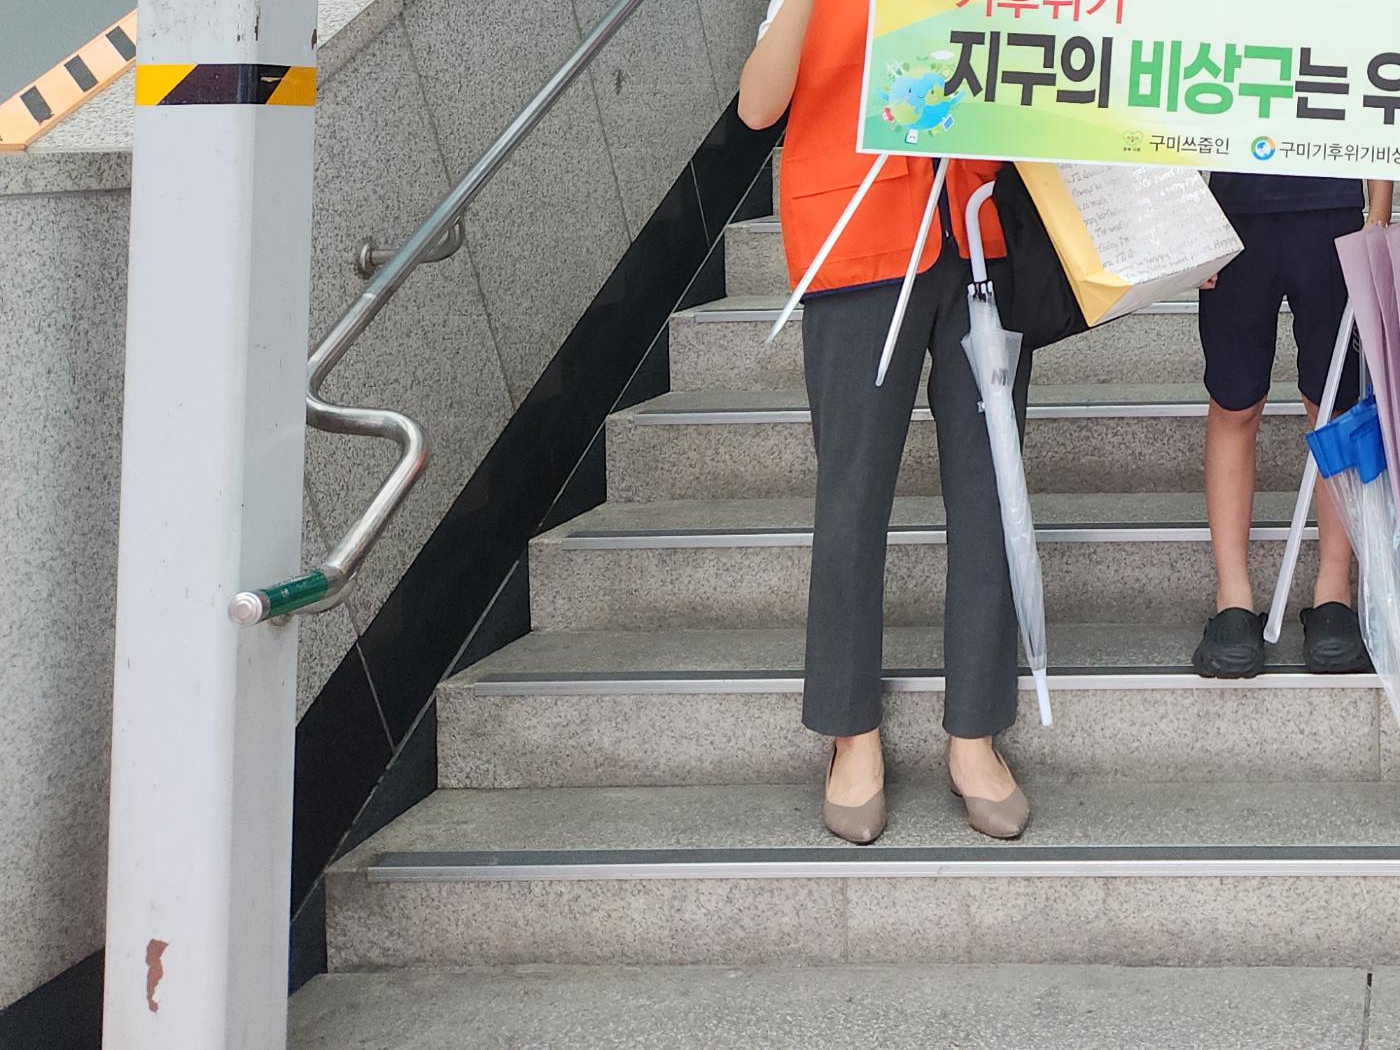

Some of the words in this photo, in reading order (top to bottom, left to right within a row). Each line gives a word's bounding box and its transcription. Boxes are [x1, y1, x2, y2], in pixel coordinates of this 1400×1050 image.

[944, 29, 1114, 109] 지구의
[1128, 40, 1349, 121] 비상구는
[1149, 134, 1229, 155] 구미쓰줍인
